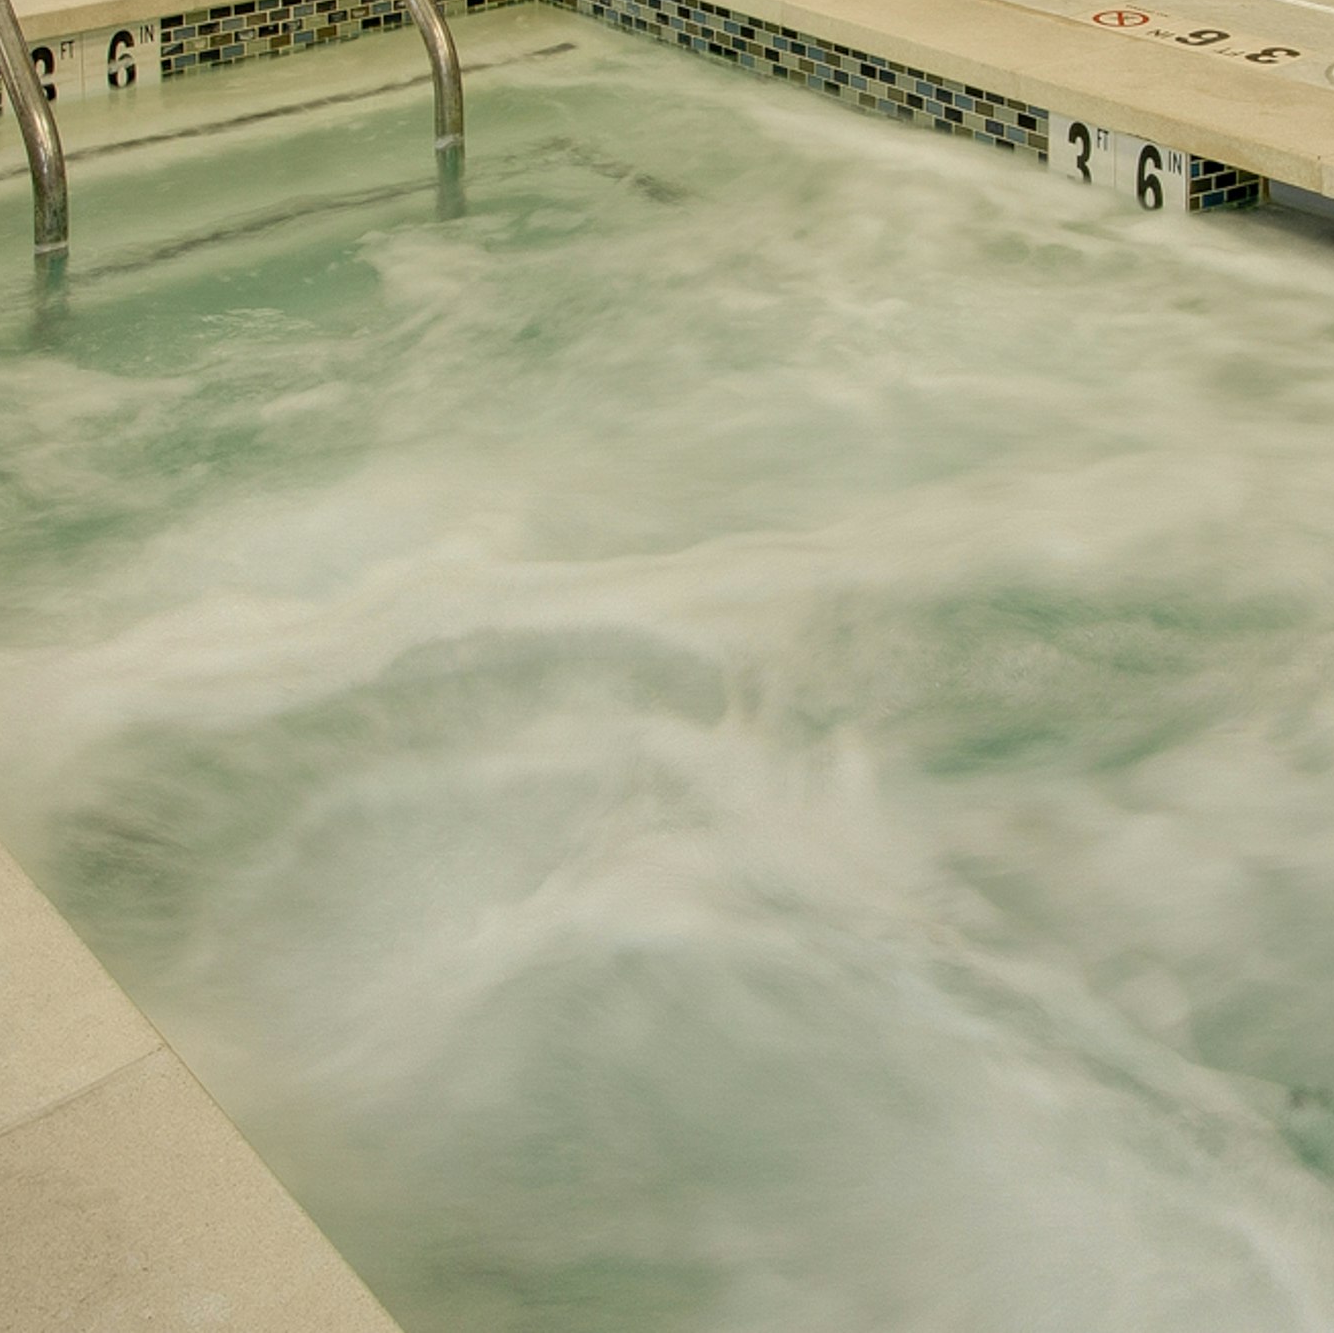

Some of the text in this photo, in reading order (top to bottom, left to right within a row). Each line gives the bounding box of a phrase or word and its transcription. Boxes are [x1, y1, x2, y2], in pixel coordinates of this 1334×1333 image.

[60, 40, 75, 60] FT
[107, 29, 137, 90] 6
[140, 25, 155, 44] IN
[1175, 29, 1230, 46] 6
[1244, 47, 1301, 64] 3
[1068, 122, 1182, 211] 3 FT 6 IN
